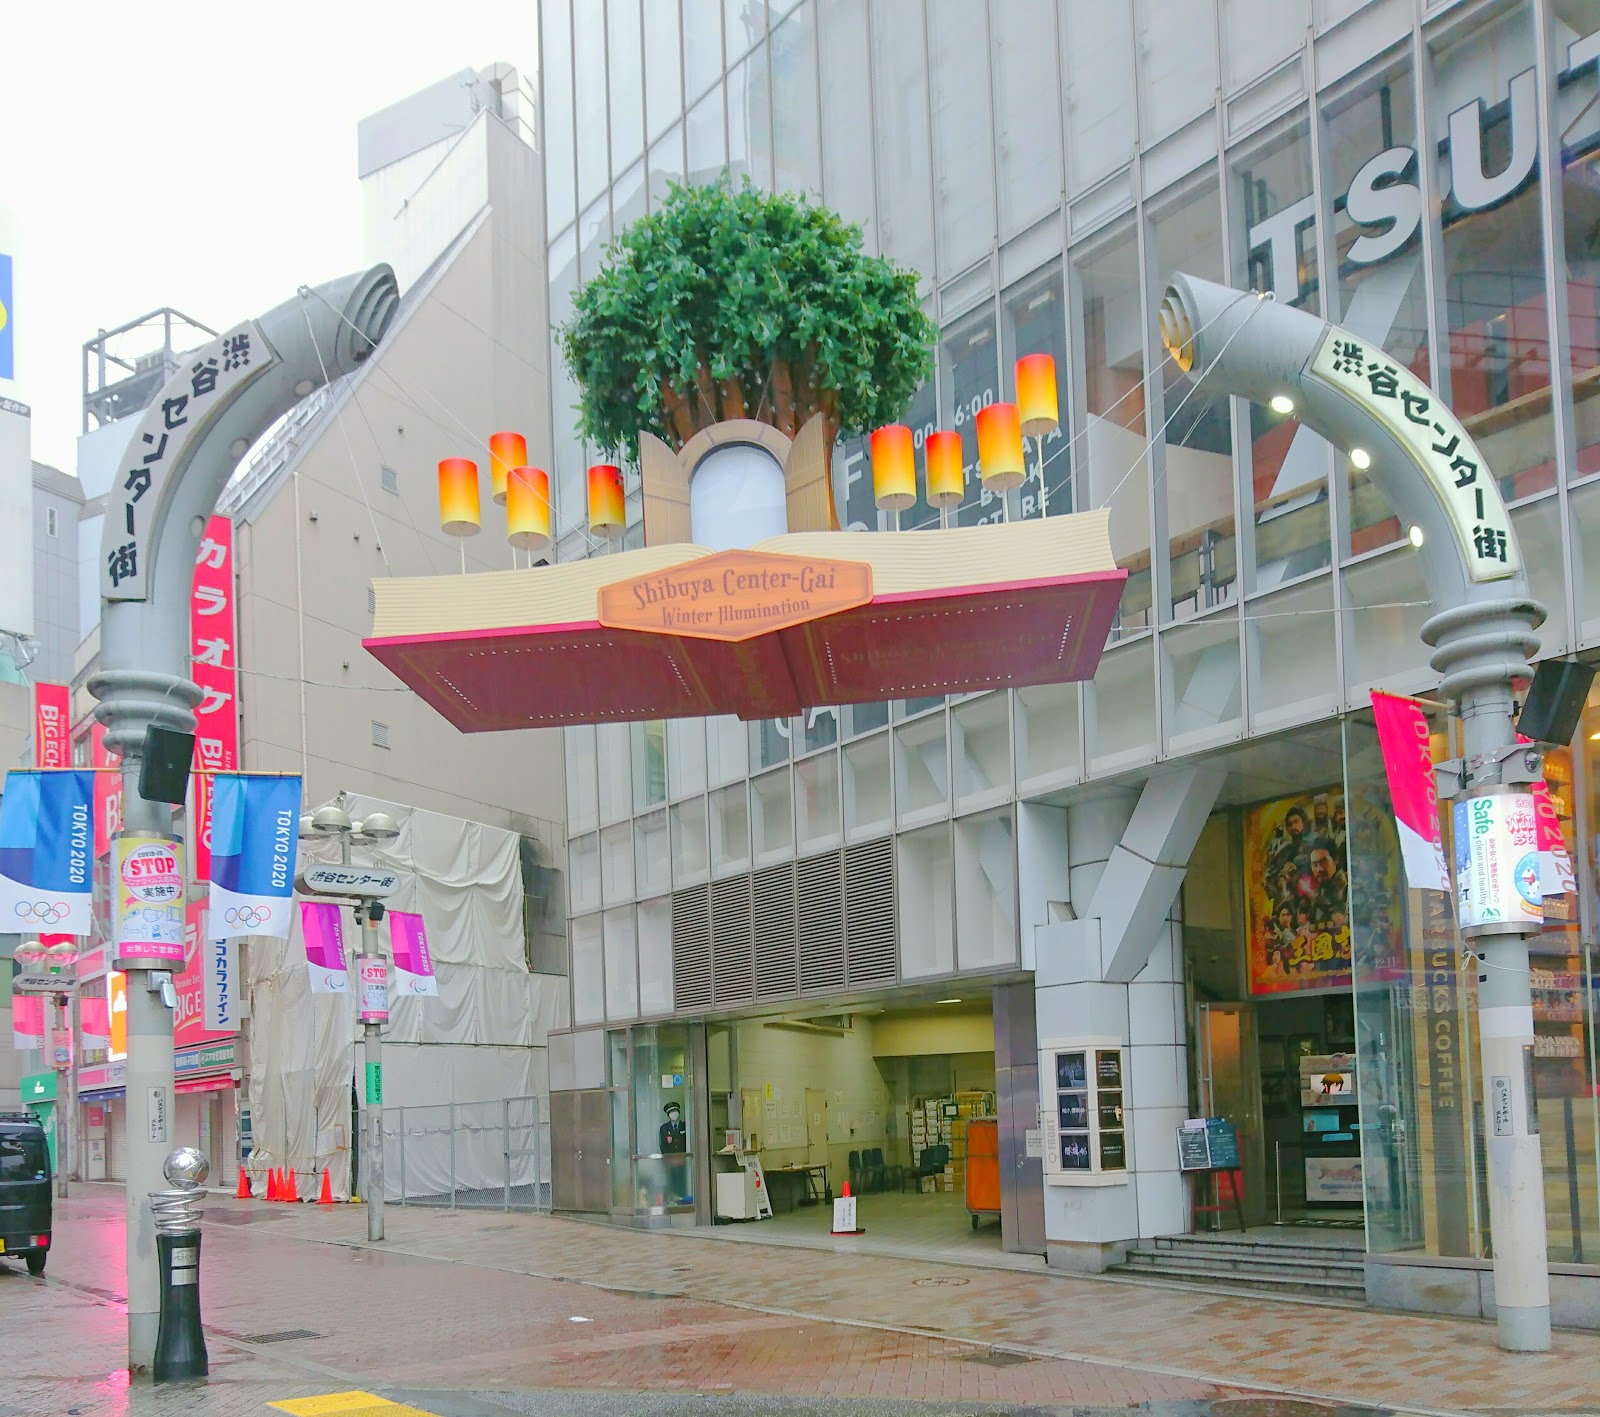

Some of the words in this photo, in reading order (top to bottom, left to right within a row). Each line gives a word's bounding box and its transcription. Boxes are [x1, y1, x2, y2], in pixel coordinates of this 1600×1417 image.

[108, 334, 250, 588] 渋谷センター街
[1332, 339, 1508, 563] 渋谷センター街
[633, 576, 714, 610] Shibuya
[723, 566, 836, 597] Center-Gai
[194, 537, 232, 715] カラオケ
[662, 606, 712, 626] Winter
[719, 599, 810, 624] Illumination
[39, 704, 59, 740] BIG
[71, 804, 88, 849] TOKYO
[274, 809, 292, 853] TOKYO
[1473, 799, 1494, 839] Safe,
[70, 850, 85, 884] 2020
[130, 857, 175, 875] STOP
[1430, 817, 1453, 892] 2020
[1475, 840, 1484, 860] clean
[1544, 826, 1578, 893] 2020
[271, 854, 288, 888] 2020
[310, 871, 395, 888] 渋谷センター街
[1477, 862, 1485, 876] and
[143, 885, 175, 898] 実施中
[1479, 877, 1488, 906] healthy
[332, 922, 341, 946] TOKYO
[336, 947, 346, 966] 2020
[416, 932, 426, 954] TOKYO
[421, 955, 430, 973] 2020
[367, 967, 387, 978] STO
[1434, 1020, 1455, 1108] COFFEE
